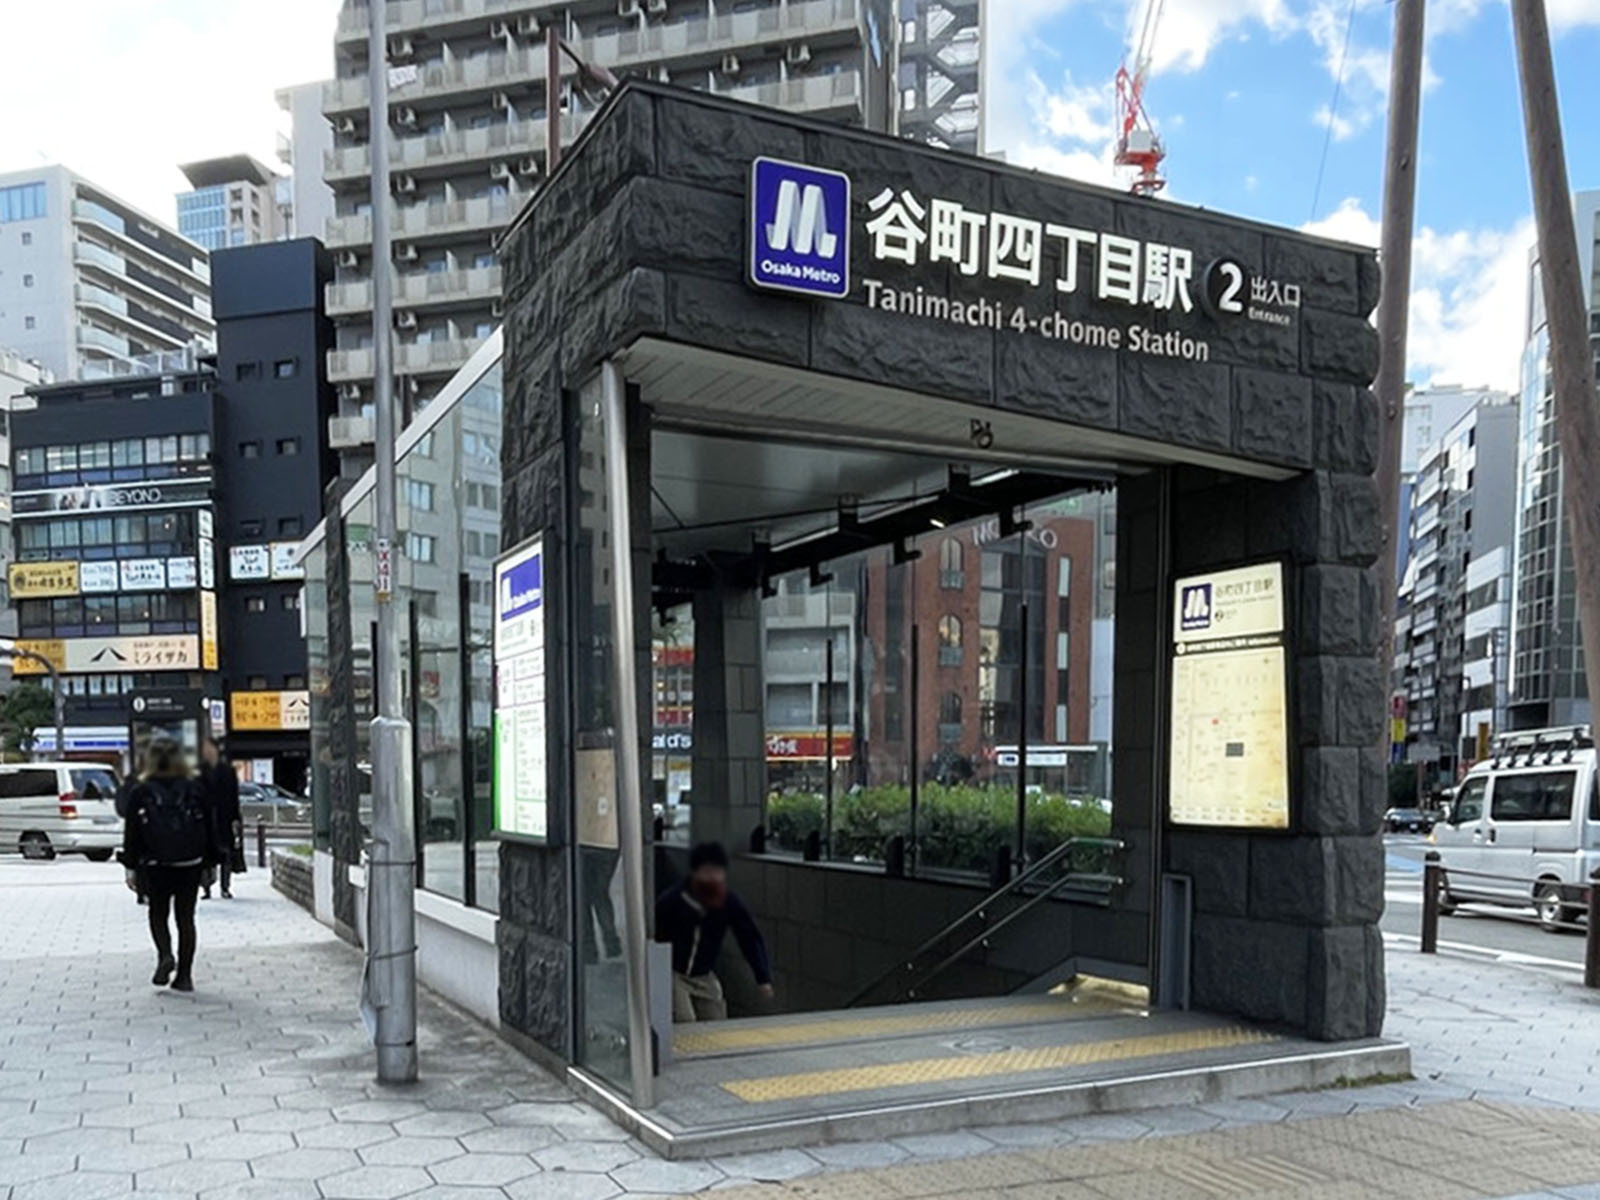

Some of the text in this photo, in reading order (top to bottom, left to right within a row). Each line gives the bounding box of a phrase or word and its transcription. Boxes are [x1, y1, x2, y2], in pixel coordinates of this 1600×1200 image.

[864, 186, 1194, 313] 谷町四丁目駅
[760, 259, 841, 285] Osaka Metro
[1218, 261, 1244, 313] 2
[1250, 275, 1301, 309] 出入口
[862, 279, 1210, 362] Tanimachi 4-chome Station
[1248, 306, 1292, 326] Entrance
[110, 488, 162, 506] BEYOND
